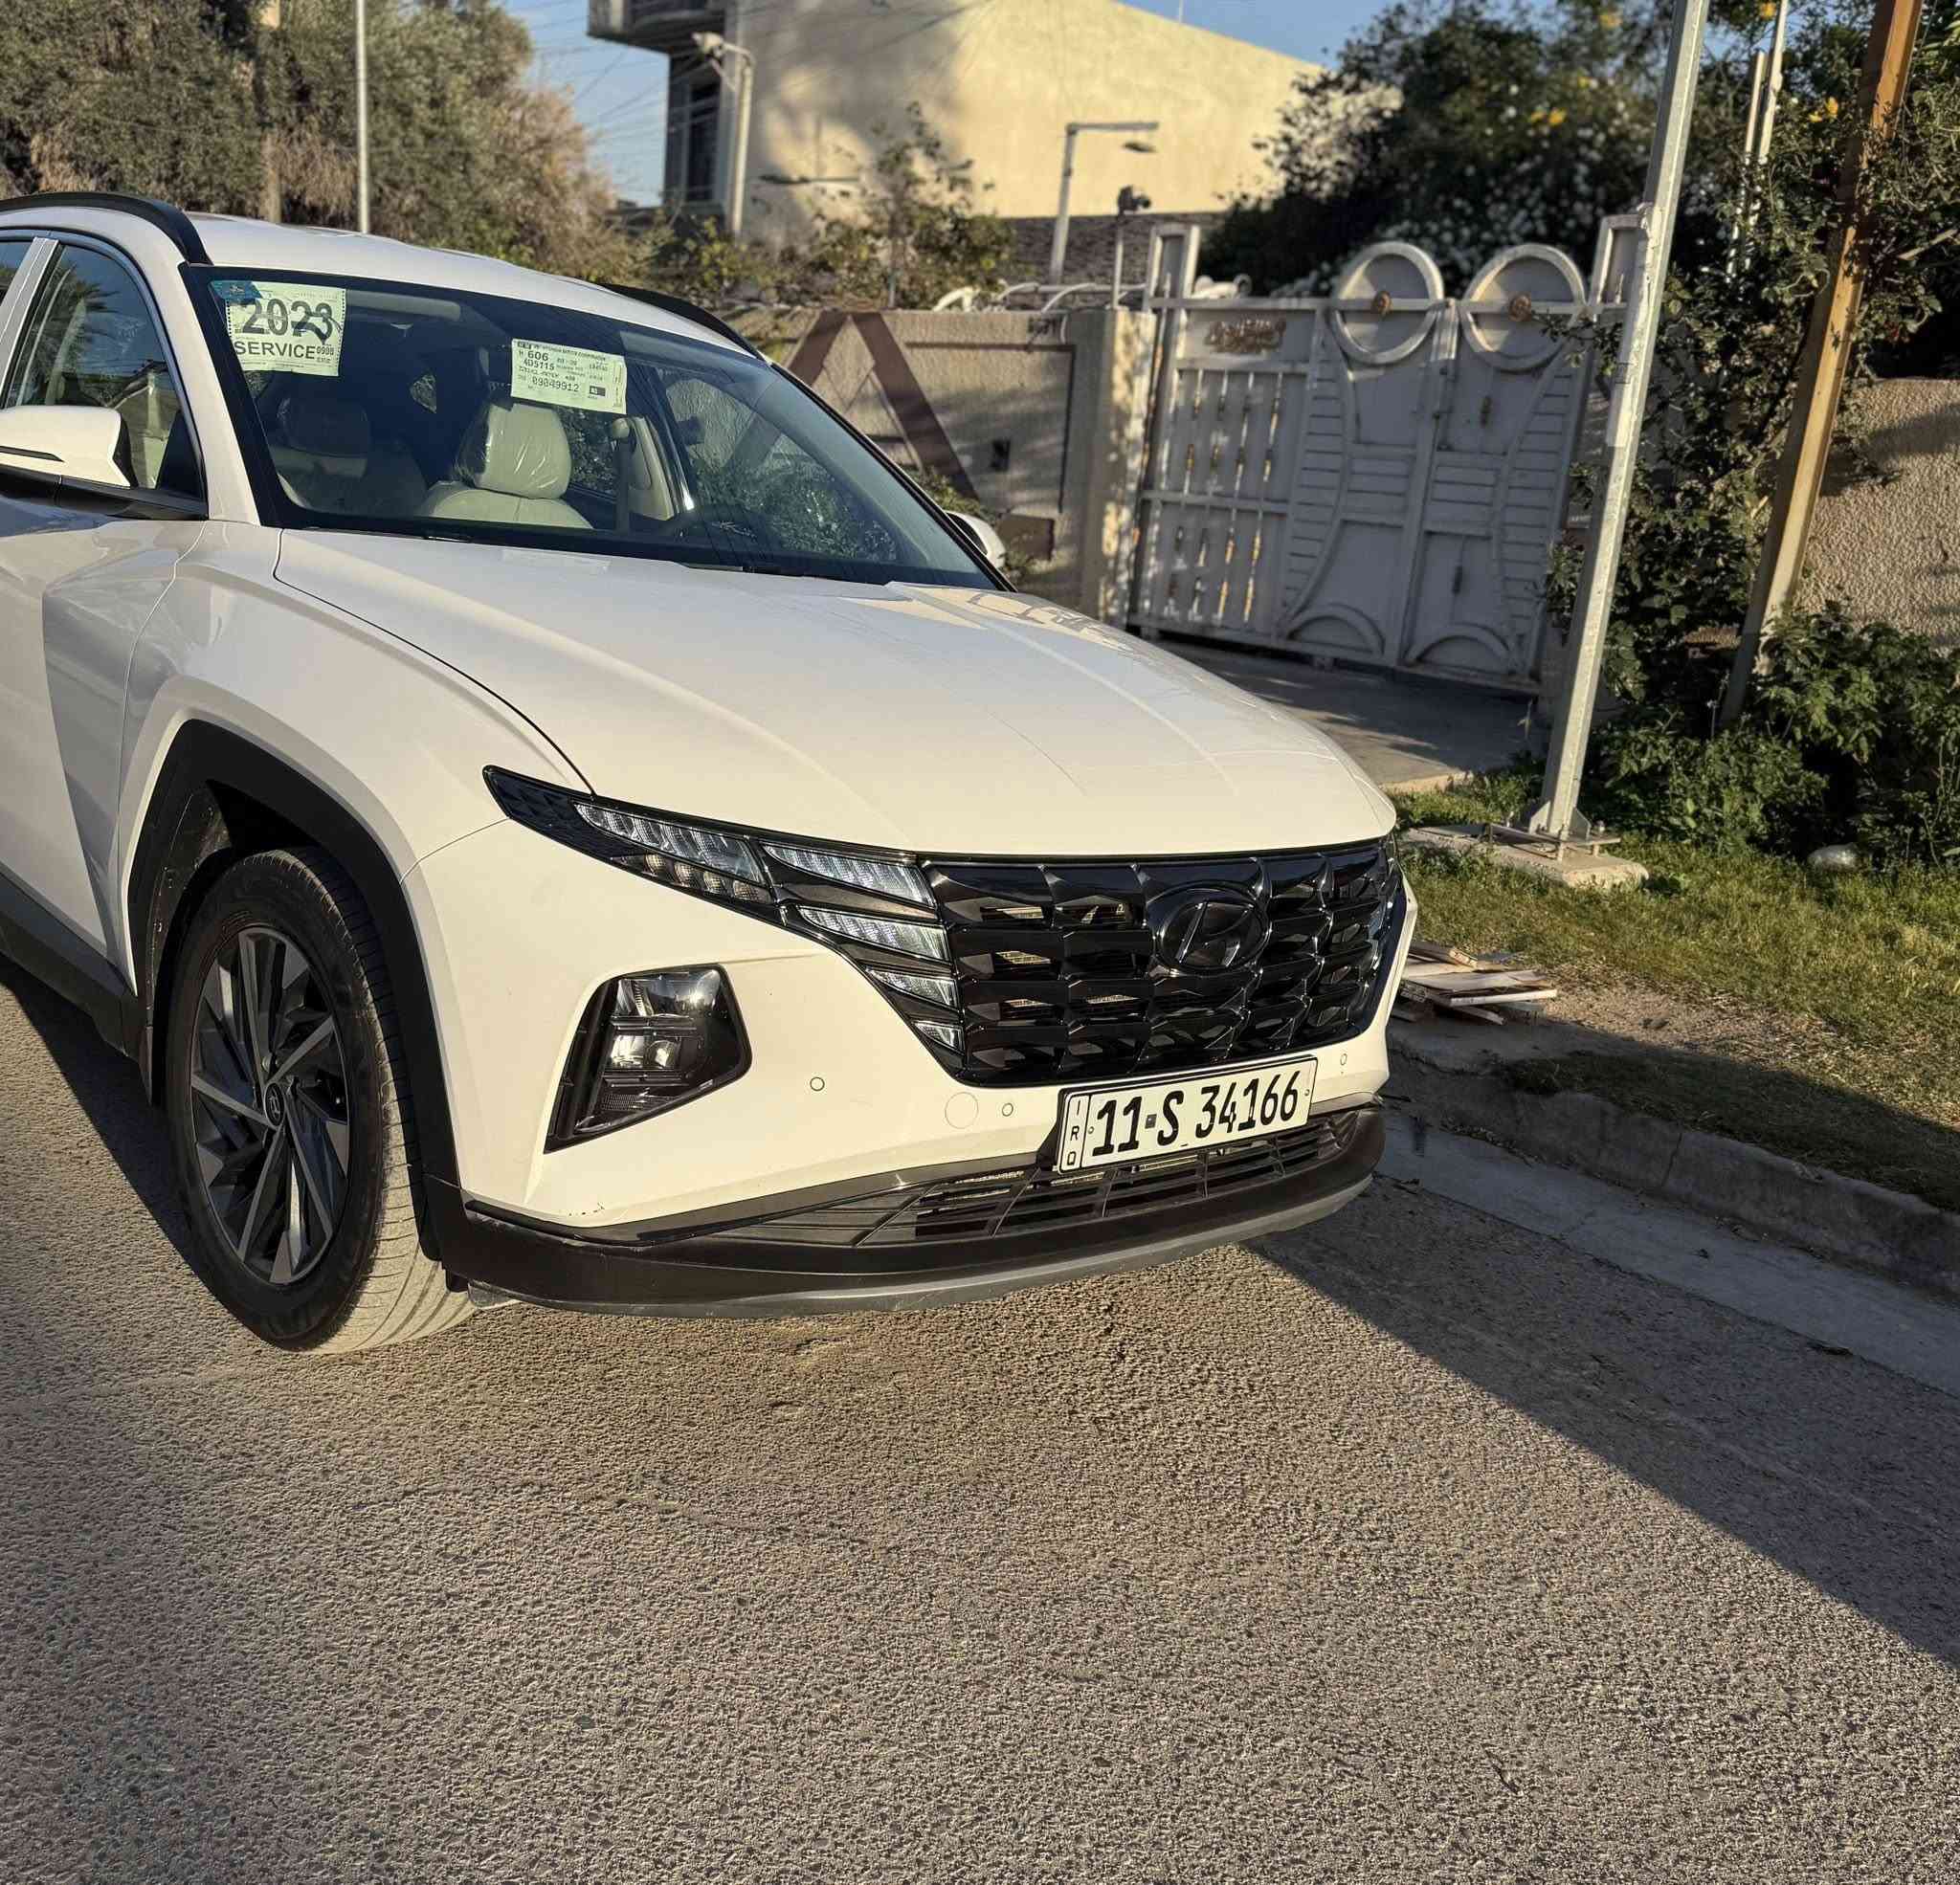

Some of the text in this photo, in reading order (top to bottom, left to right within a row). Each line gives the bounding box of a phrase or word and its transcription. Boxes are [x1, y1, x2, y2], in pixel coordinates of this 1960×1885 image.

[234, 341, 315, 359] SERVICE
[527, 350, 549, 362] 606
[1194, 1070, 1302, 1140] 34166
